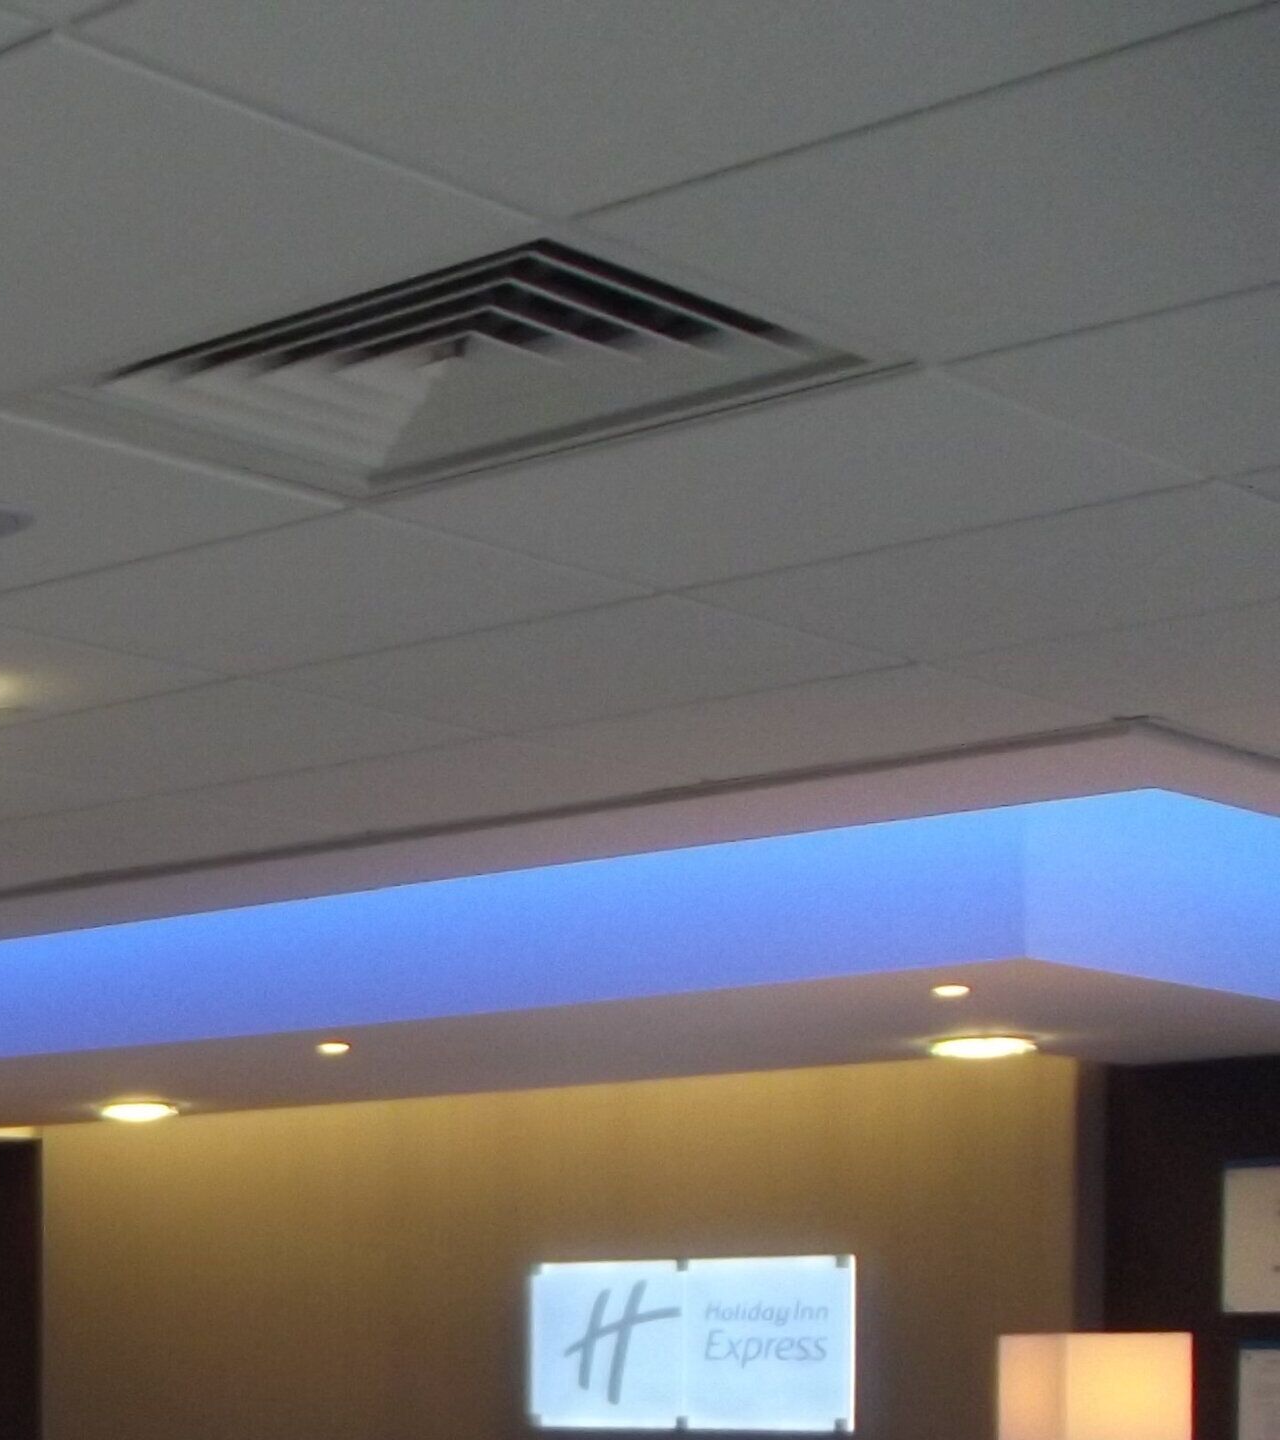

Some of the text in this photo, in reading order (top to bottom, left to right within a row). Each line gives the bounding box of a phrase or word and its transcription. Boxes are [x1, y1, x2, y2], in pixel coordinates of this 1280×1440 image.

[704, 1299, 829, 1327] Holiday Inn
[703, 1329, 828, 1370] Express
